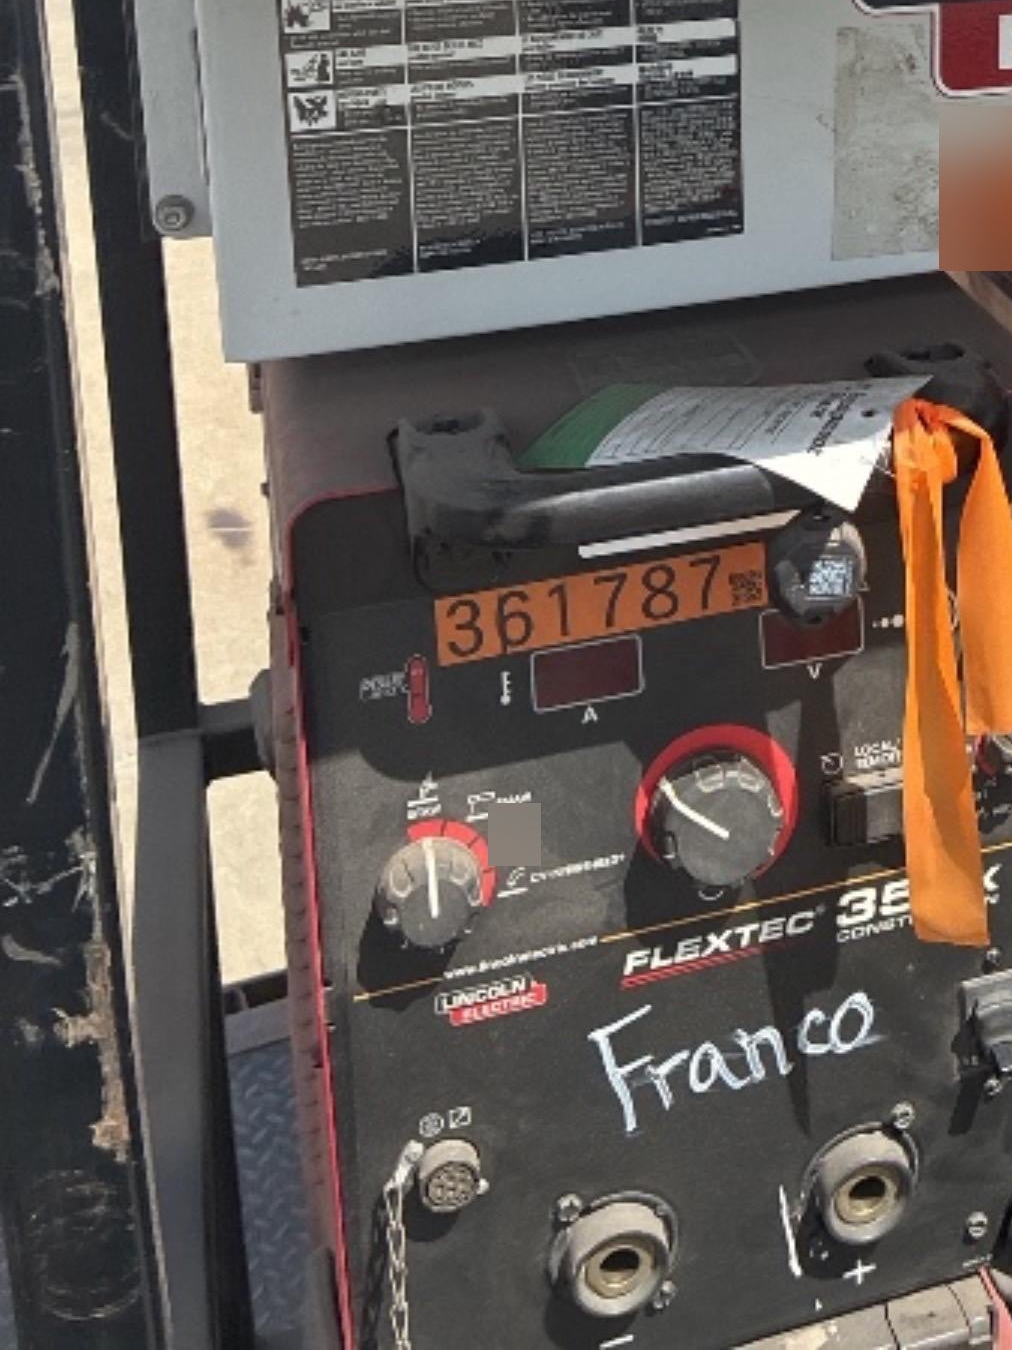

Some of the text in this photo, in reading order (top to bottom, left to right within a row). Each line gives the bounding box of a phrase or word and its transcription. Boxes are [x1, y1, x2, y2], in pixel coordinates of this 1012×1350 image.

[446, 554, 722, 658] 361787
[623, 910, 816, 976] FLEXTEC
[587, 991, 875, 1132] Franco
